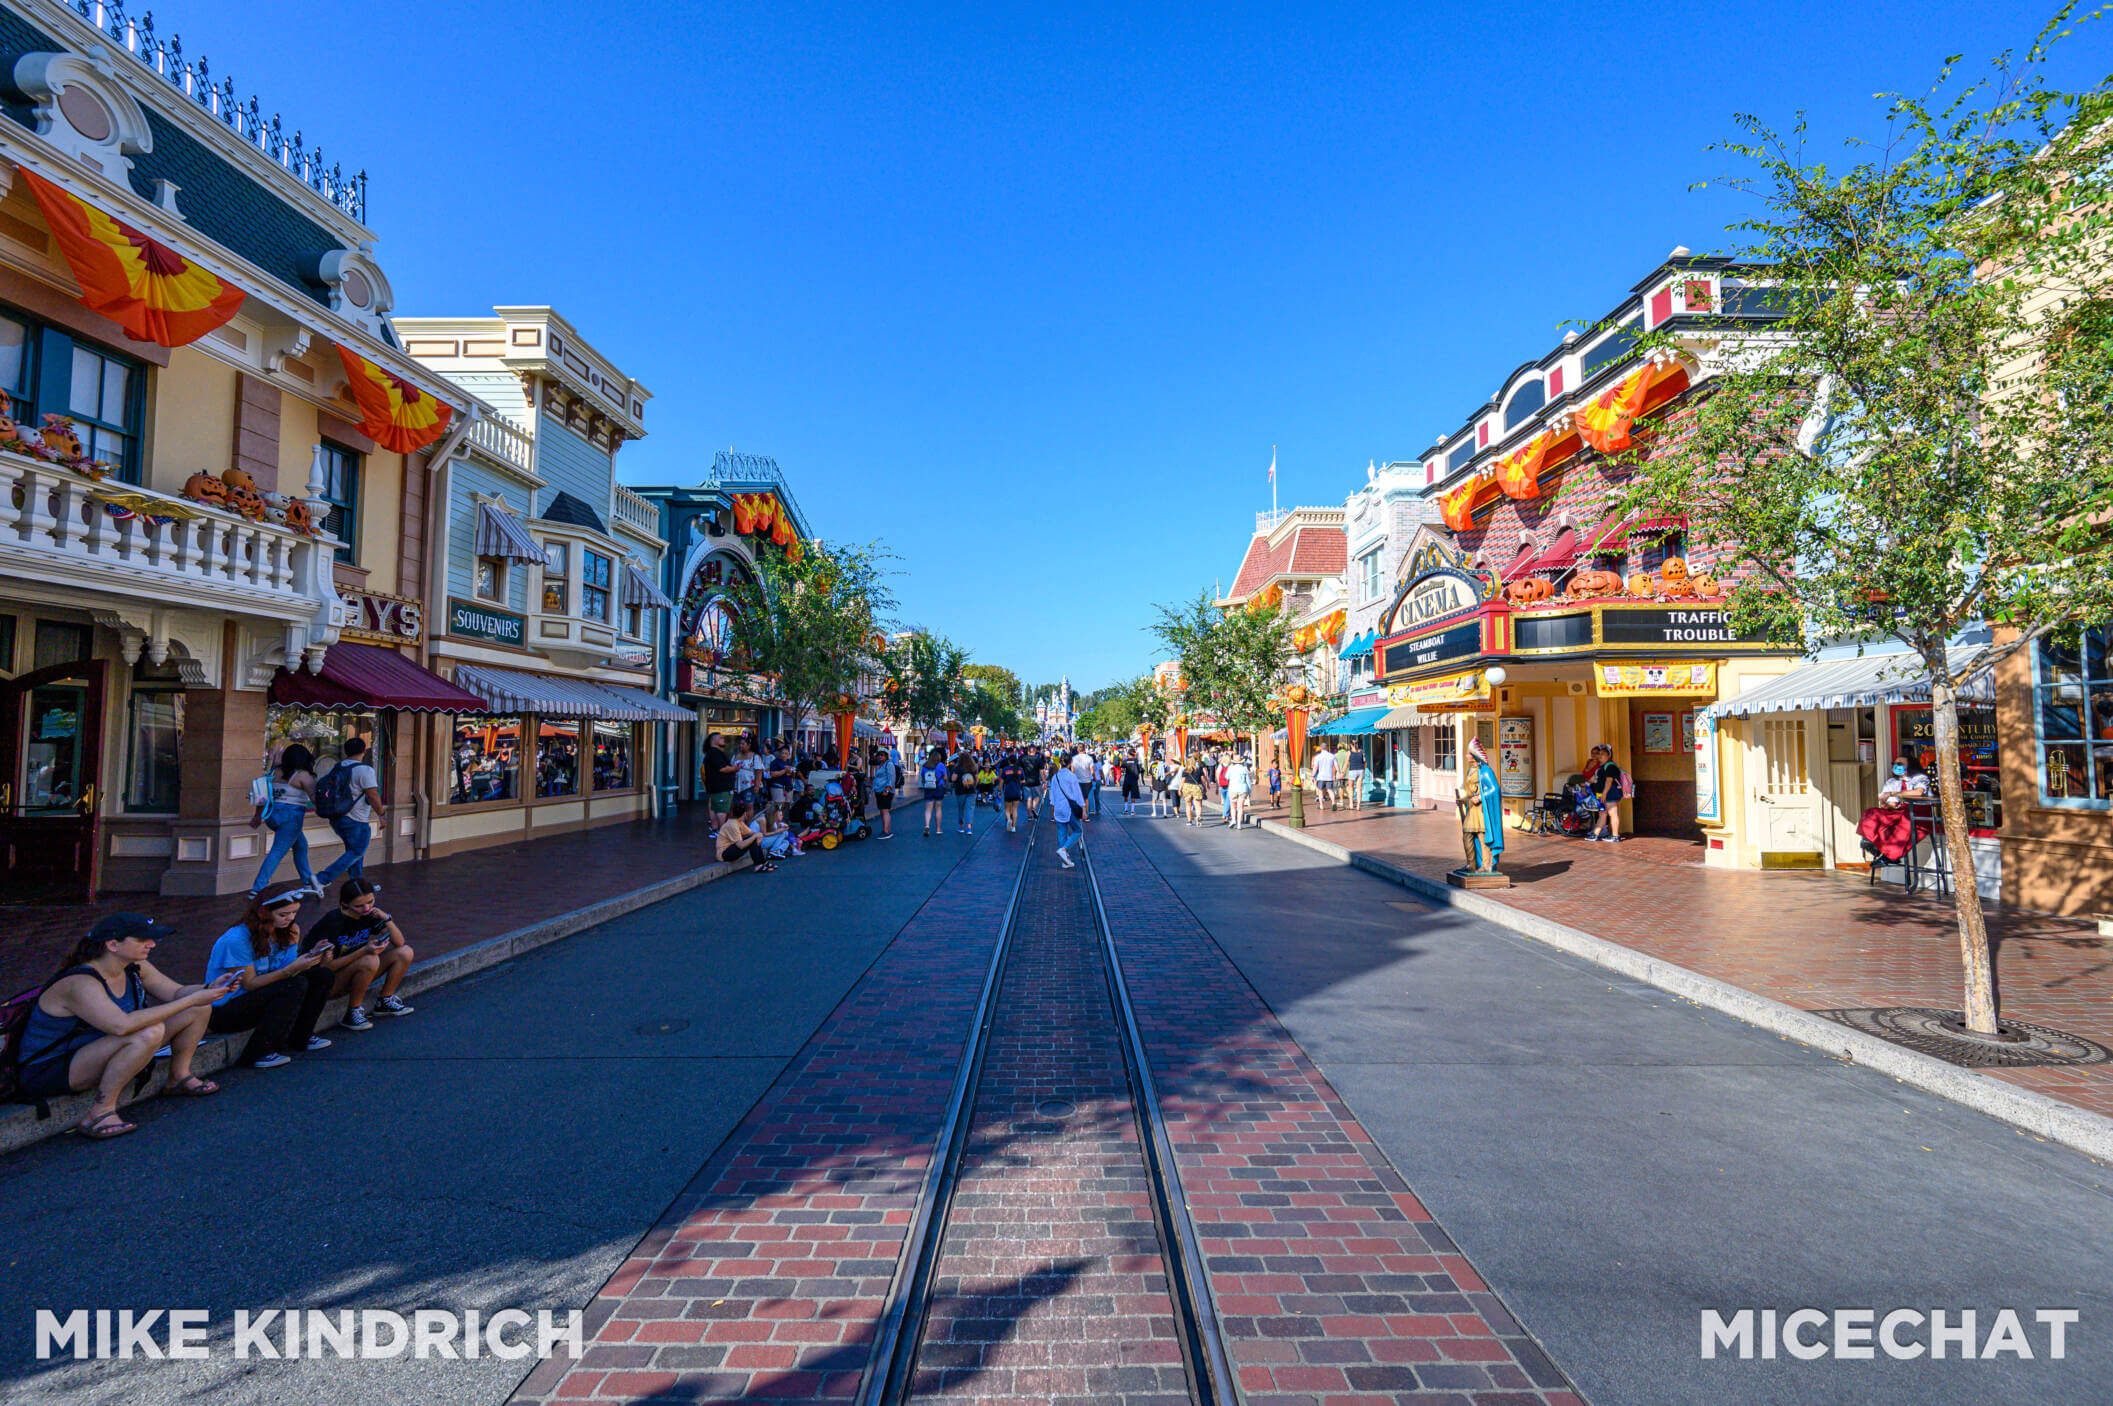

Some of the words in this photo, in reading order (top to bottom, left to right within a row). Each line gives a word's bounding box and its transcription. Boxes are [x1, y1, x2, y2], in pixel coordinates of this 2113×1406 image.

[1400, 584, 1463, 627] CINEMA
[456, 609, 519, 639] SOUVENIRS
[1409, 634, 1446, 653] STEAMBOAT
[1663, 629, 1737, 641] TROUBLE
[1416, 650, 1438, 665] WILLIE
[1913, 723, 1935, 737] 20
[1959, 724, 1996, 734] NTURY
